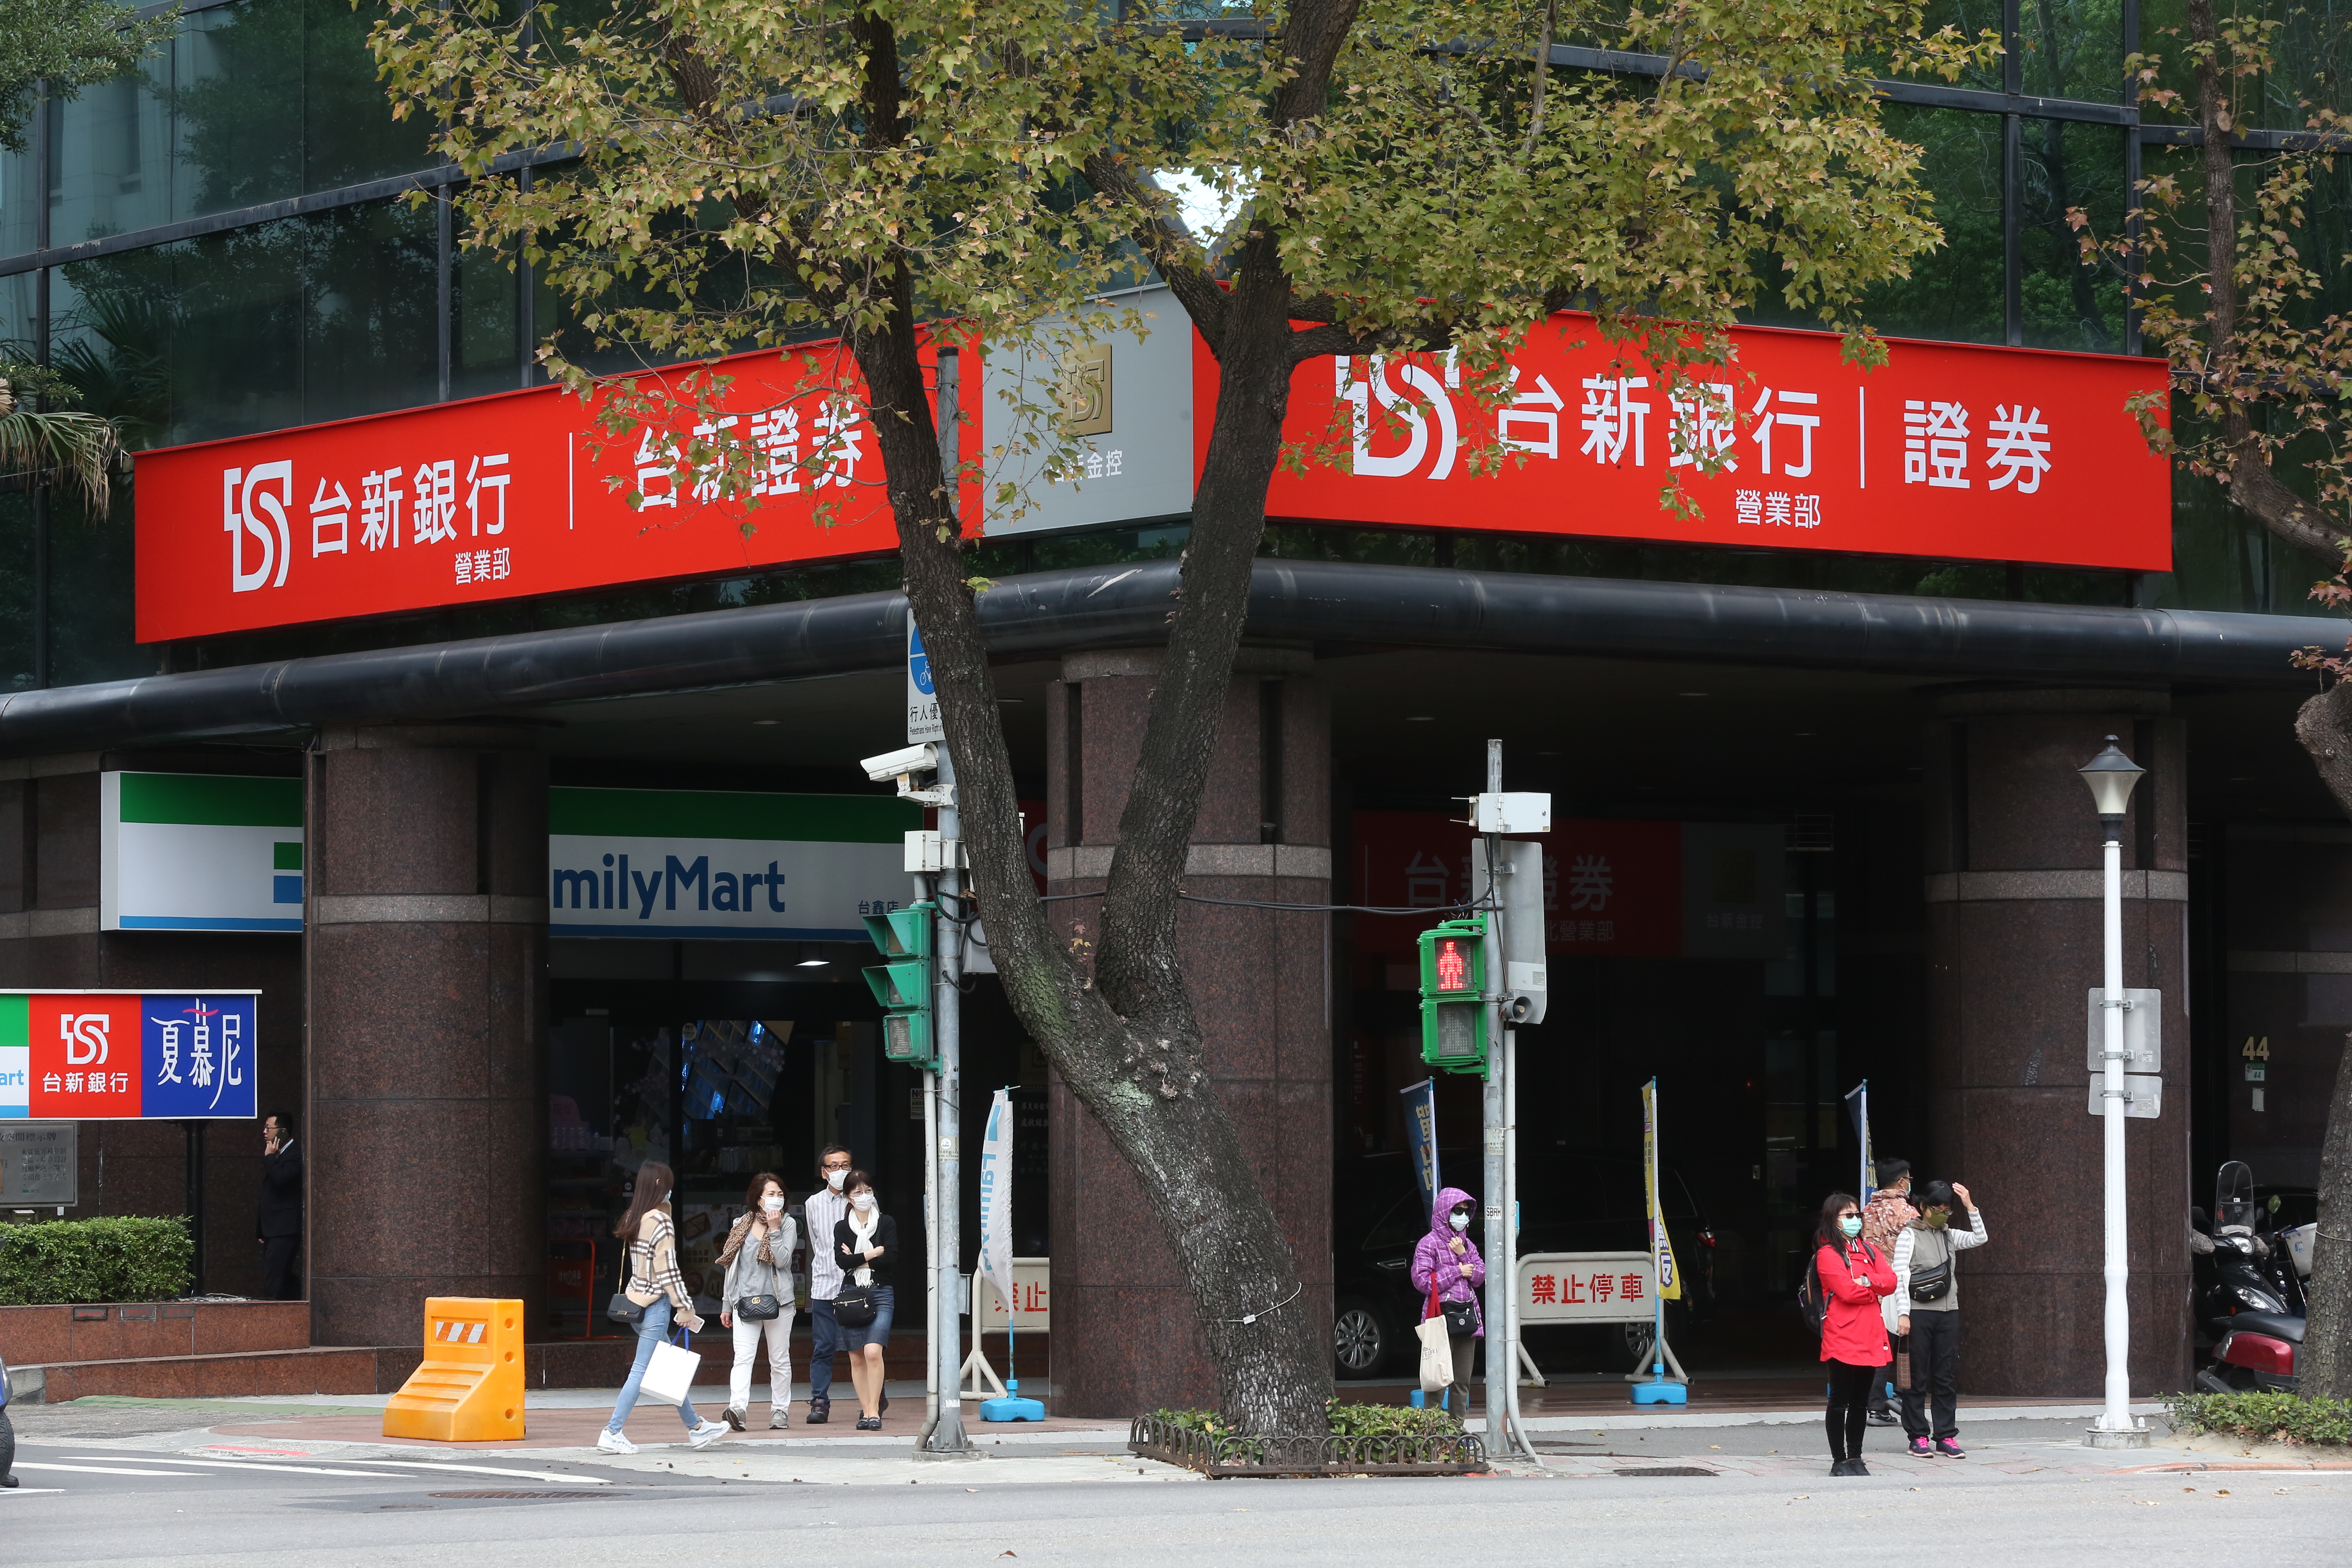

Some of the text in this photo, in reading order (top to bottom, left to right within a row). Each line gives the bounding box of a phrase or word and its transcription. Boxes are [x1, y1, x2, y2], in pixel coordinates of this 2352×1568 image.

[1494, 364, 2053, 494] 台新銀行 證券
[308, 453, 511, 559] 台新銀行
[1735, 488, 1822, 529] 營業部
[454, 547, 511, 586] 營業部
[910, 703, 938, 723] 行人優
[910, 726, 924, 735] Pedestrians
[553, 853, 785, 919] milyMart
[1405, 850, 1613, 912] 台券
[858, 900, 899, 914] 台鑫店
[1706, 912, 1763, 929] 台新金控
[151, 998, 242, 1110] 夏慕尼
[2243, 1036, 2270, 1061] 44
[42, 1071, 129, 1094] 台新銀行
[1531, 1273, 1645, 1305] 禁止停車
